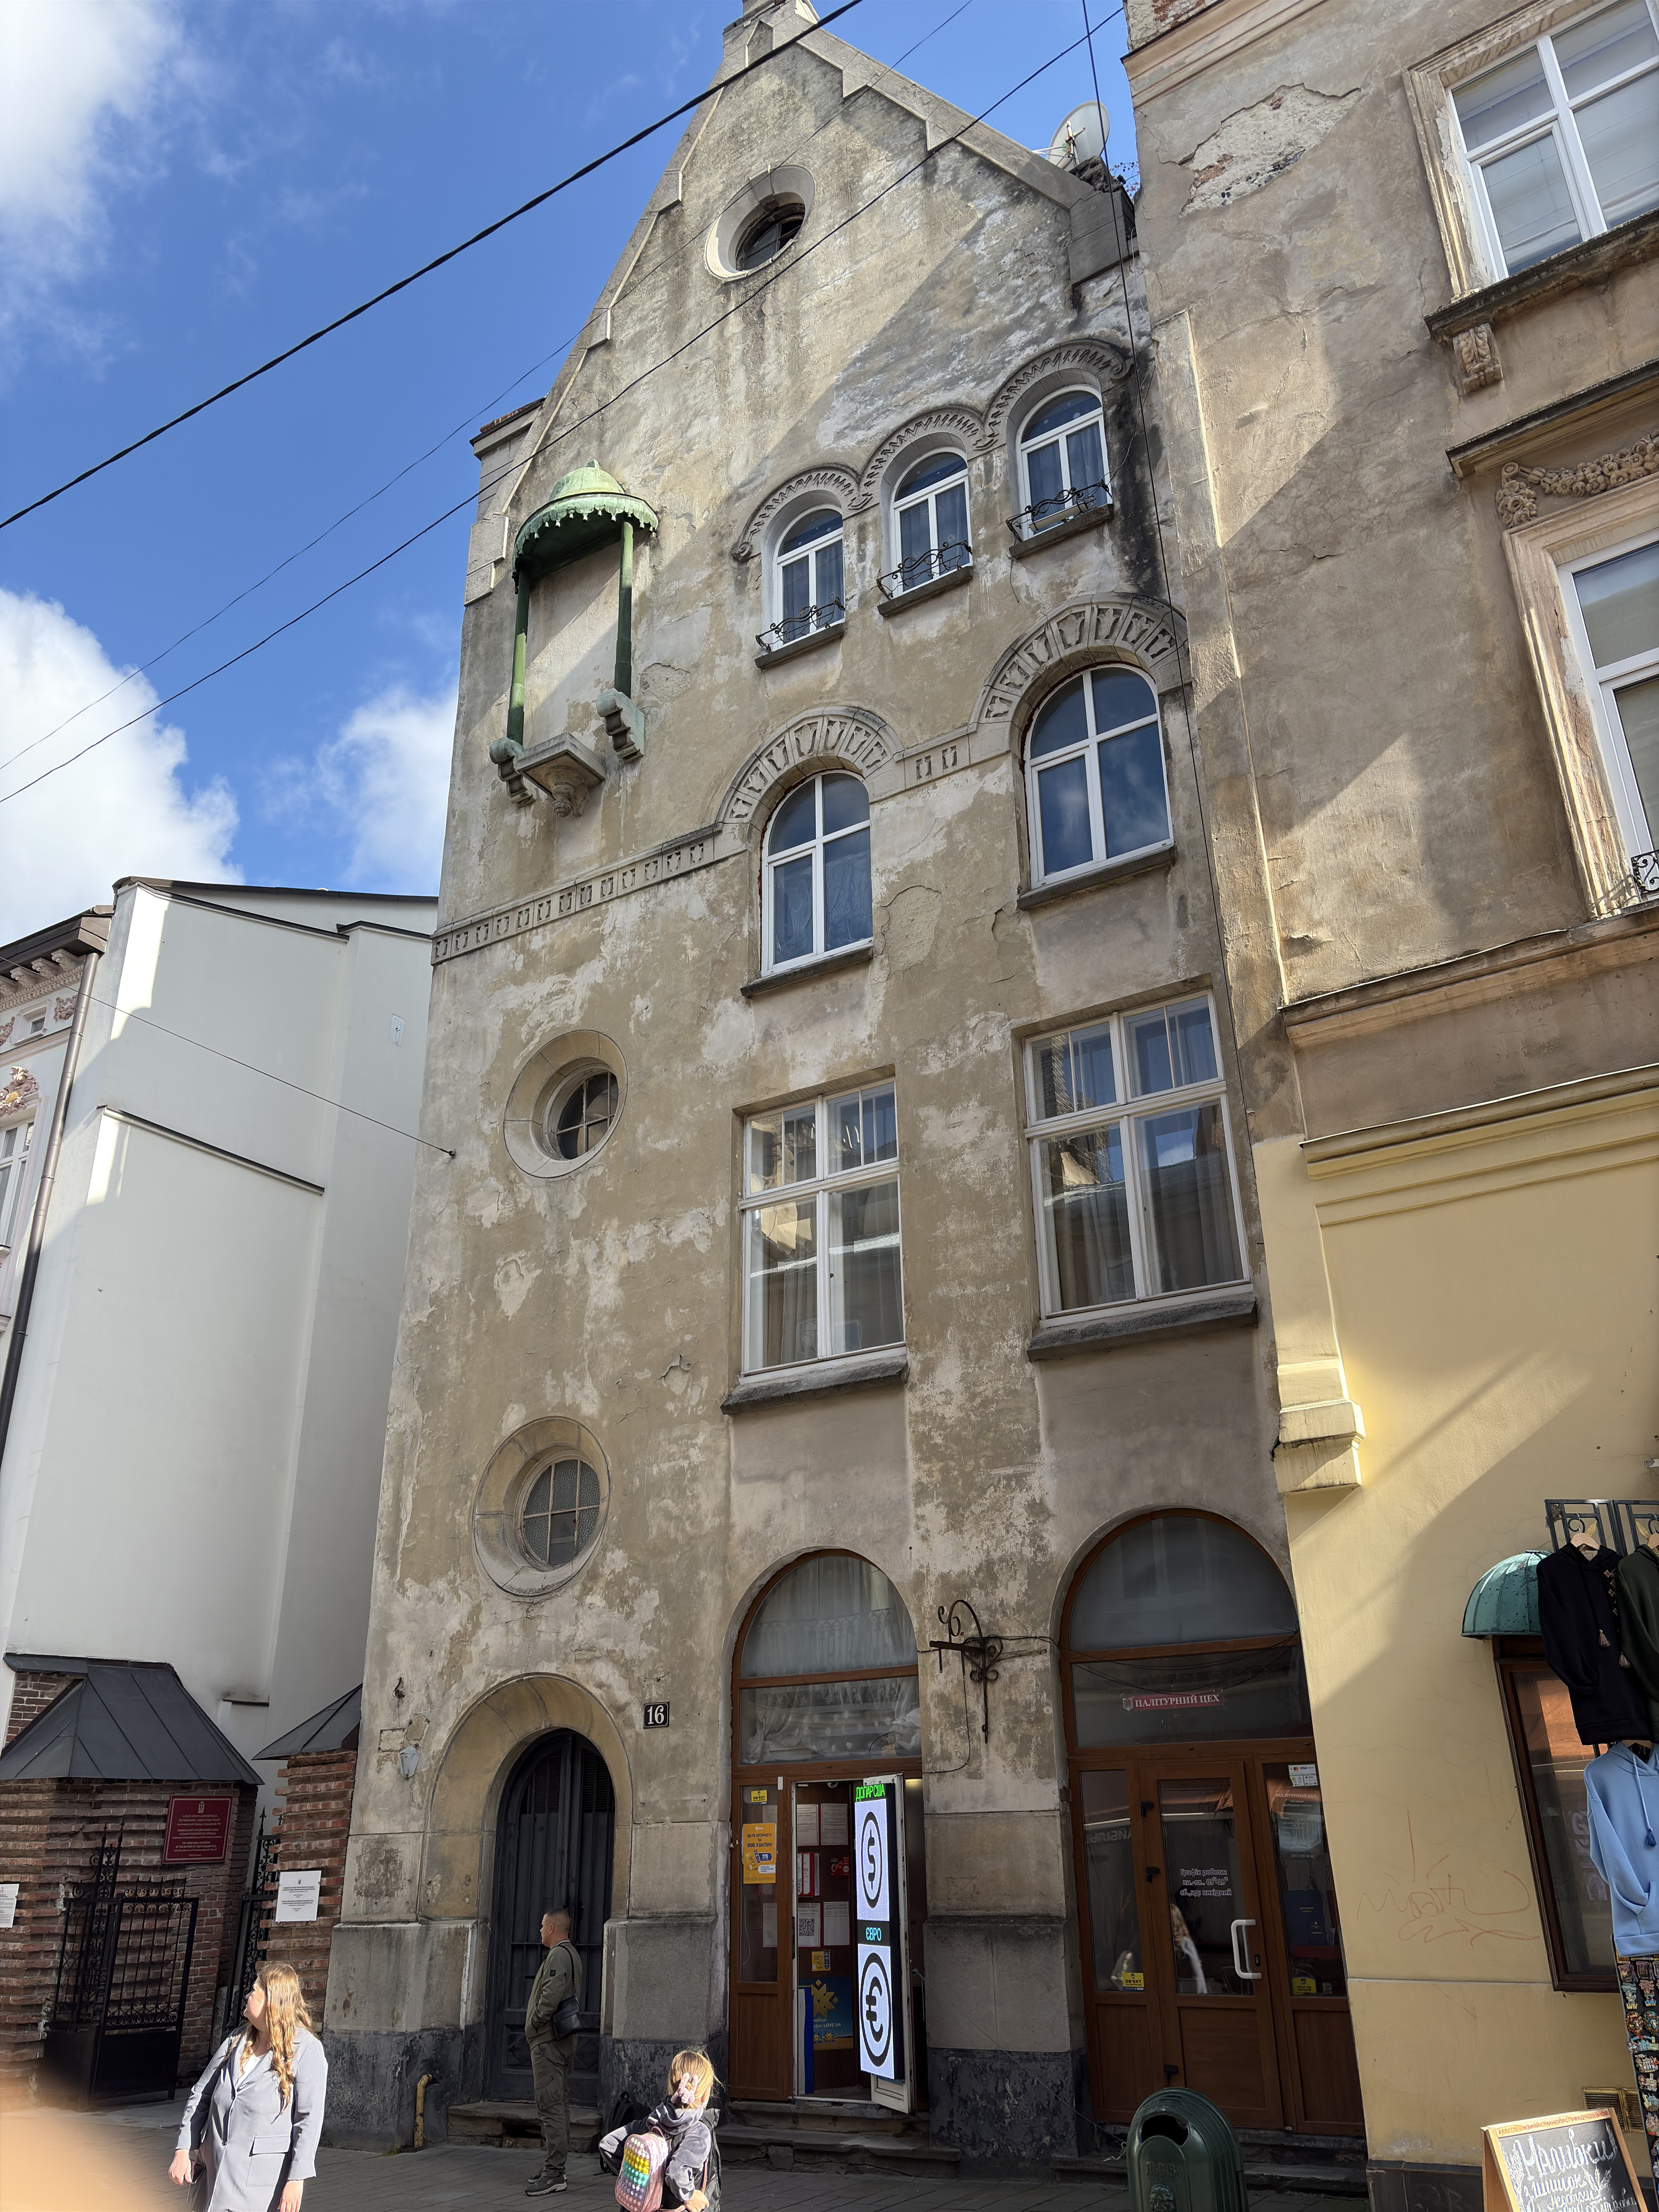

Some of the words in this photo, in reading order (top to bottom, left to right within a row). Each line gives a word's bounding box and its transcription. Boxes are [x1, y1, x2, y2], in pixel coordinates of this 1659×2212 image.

[1135, 1694, 1197, 1708] ПАЛІТУРНИЙ
[1199, 1694, 1220, 1704] ЦЕХ
[647, 1705, 665, 1724] 16
[855, 1785, 874, 1802] ДОЛАР
[873, 1783, 885, 1797] США
[1202, 1868, 1228, 1876] роботи:
[1202, 1888, 1232, 1897] вихідний
[865, 1927, 881, 1942] ЄВРО
[1514, 2127, 1616, 2181] Наливки
